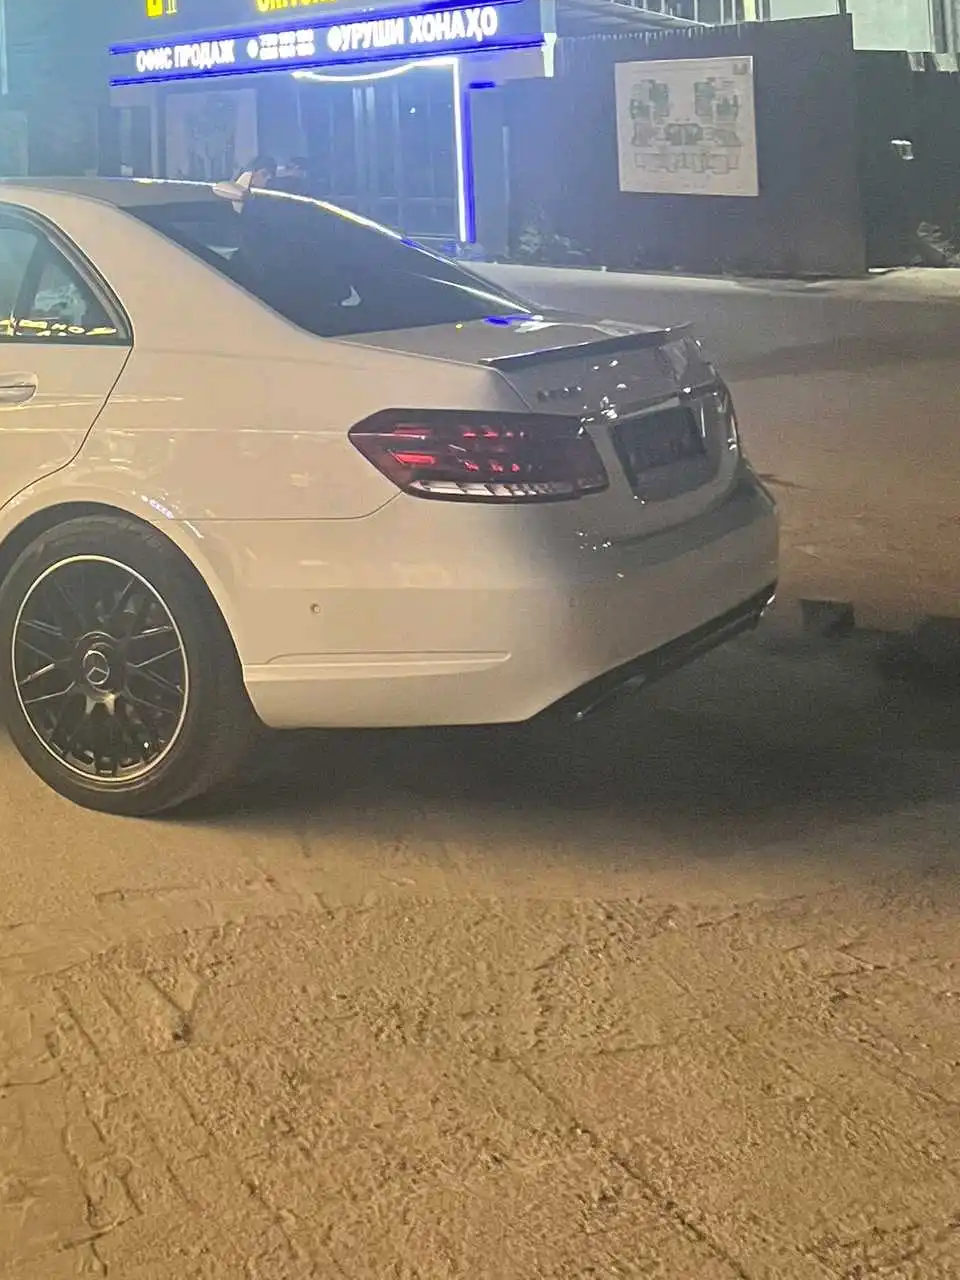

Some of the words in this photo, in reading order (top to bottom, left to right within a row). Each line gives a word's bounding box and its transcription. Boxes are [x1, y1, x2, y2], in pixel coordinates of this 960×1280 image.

[409, 6, 498, 42] ХОНАҲО
[136, 47, 173, 72] ОФИС
[174, 39, 235, 69] ПРОДАЖ
